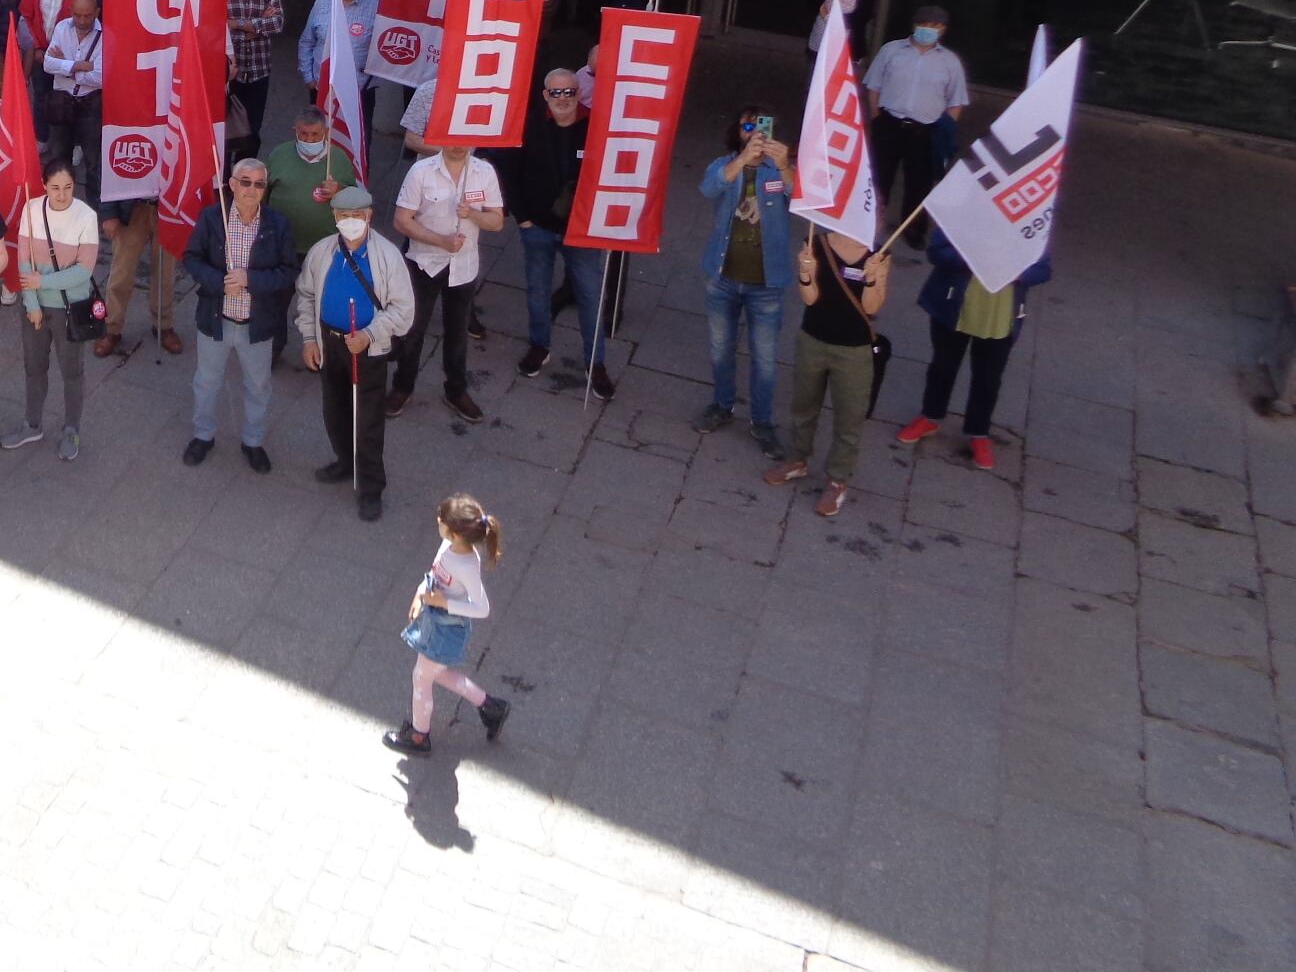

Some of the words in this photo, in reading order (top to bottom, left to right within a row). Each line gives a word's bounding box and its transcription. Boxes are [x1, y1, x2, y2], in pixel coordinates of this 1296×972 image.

[384, 31, 418, 51] UGT
[587, 25, 676, 240] CCOO
[114, 141, 154, 160] UGT
